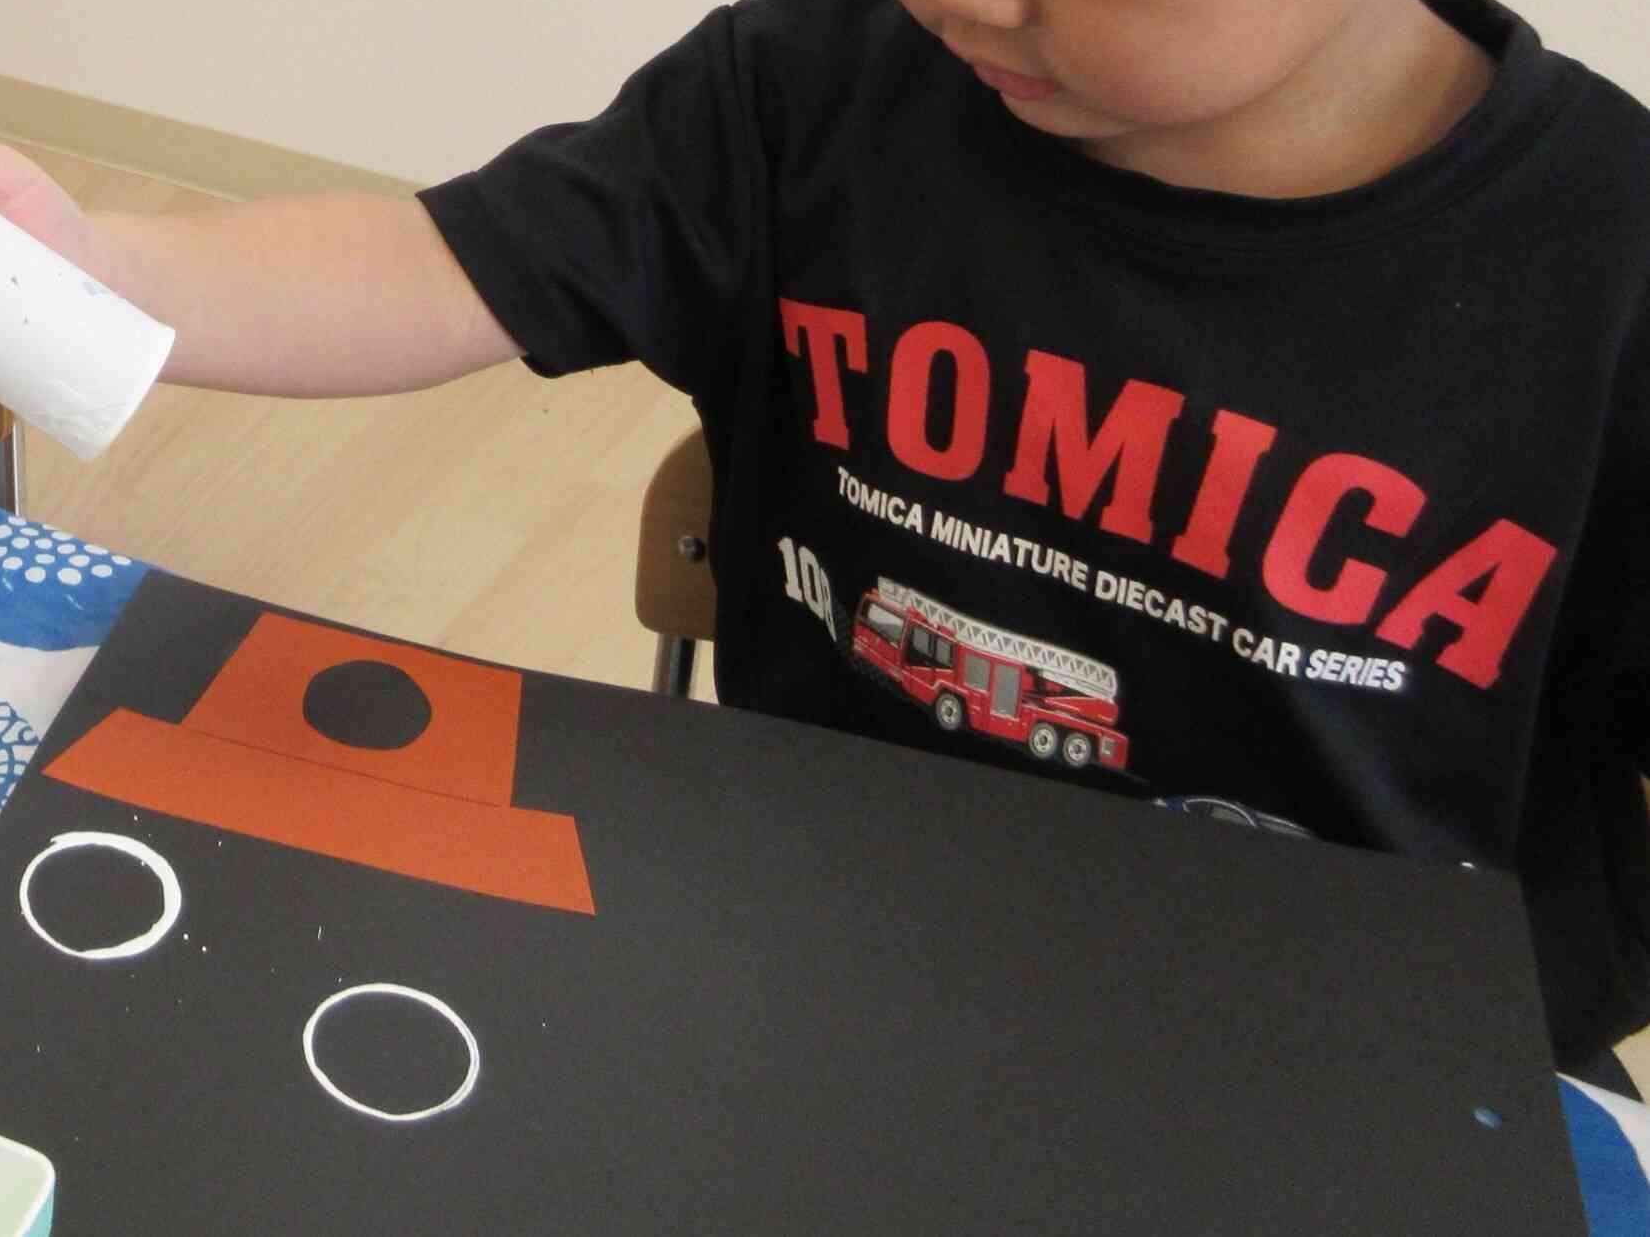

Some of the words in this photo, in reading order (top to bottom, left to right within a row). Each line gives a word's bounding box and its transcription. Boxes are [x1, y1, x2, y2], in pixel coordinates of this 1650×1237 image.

[779, 298, 1558, 690] TOMICA
[837, 465, 924, 535] TOMICA
[930, 510, 1089, 592] MINIATURE
[1094, 570, 1228, 642] DIECAST
[1232, 628, 1301, 677] CAR
[1305, 649, 1406, 691] SERIES
